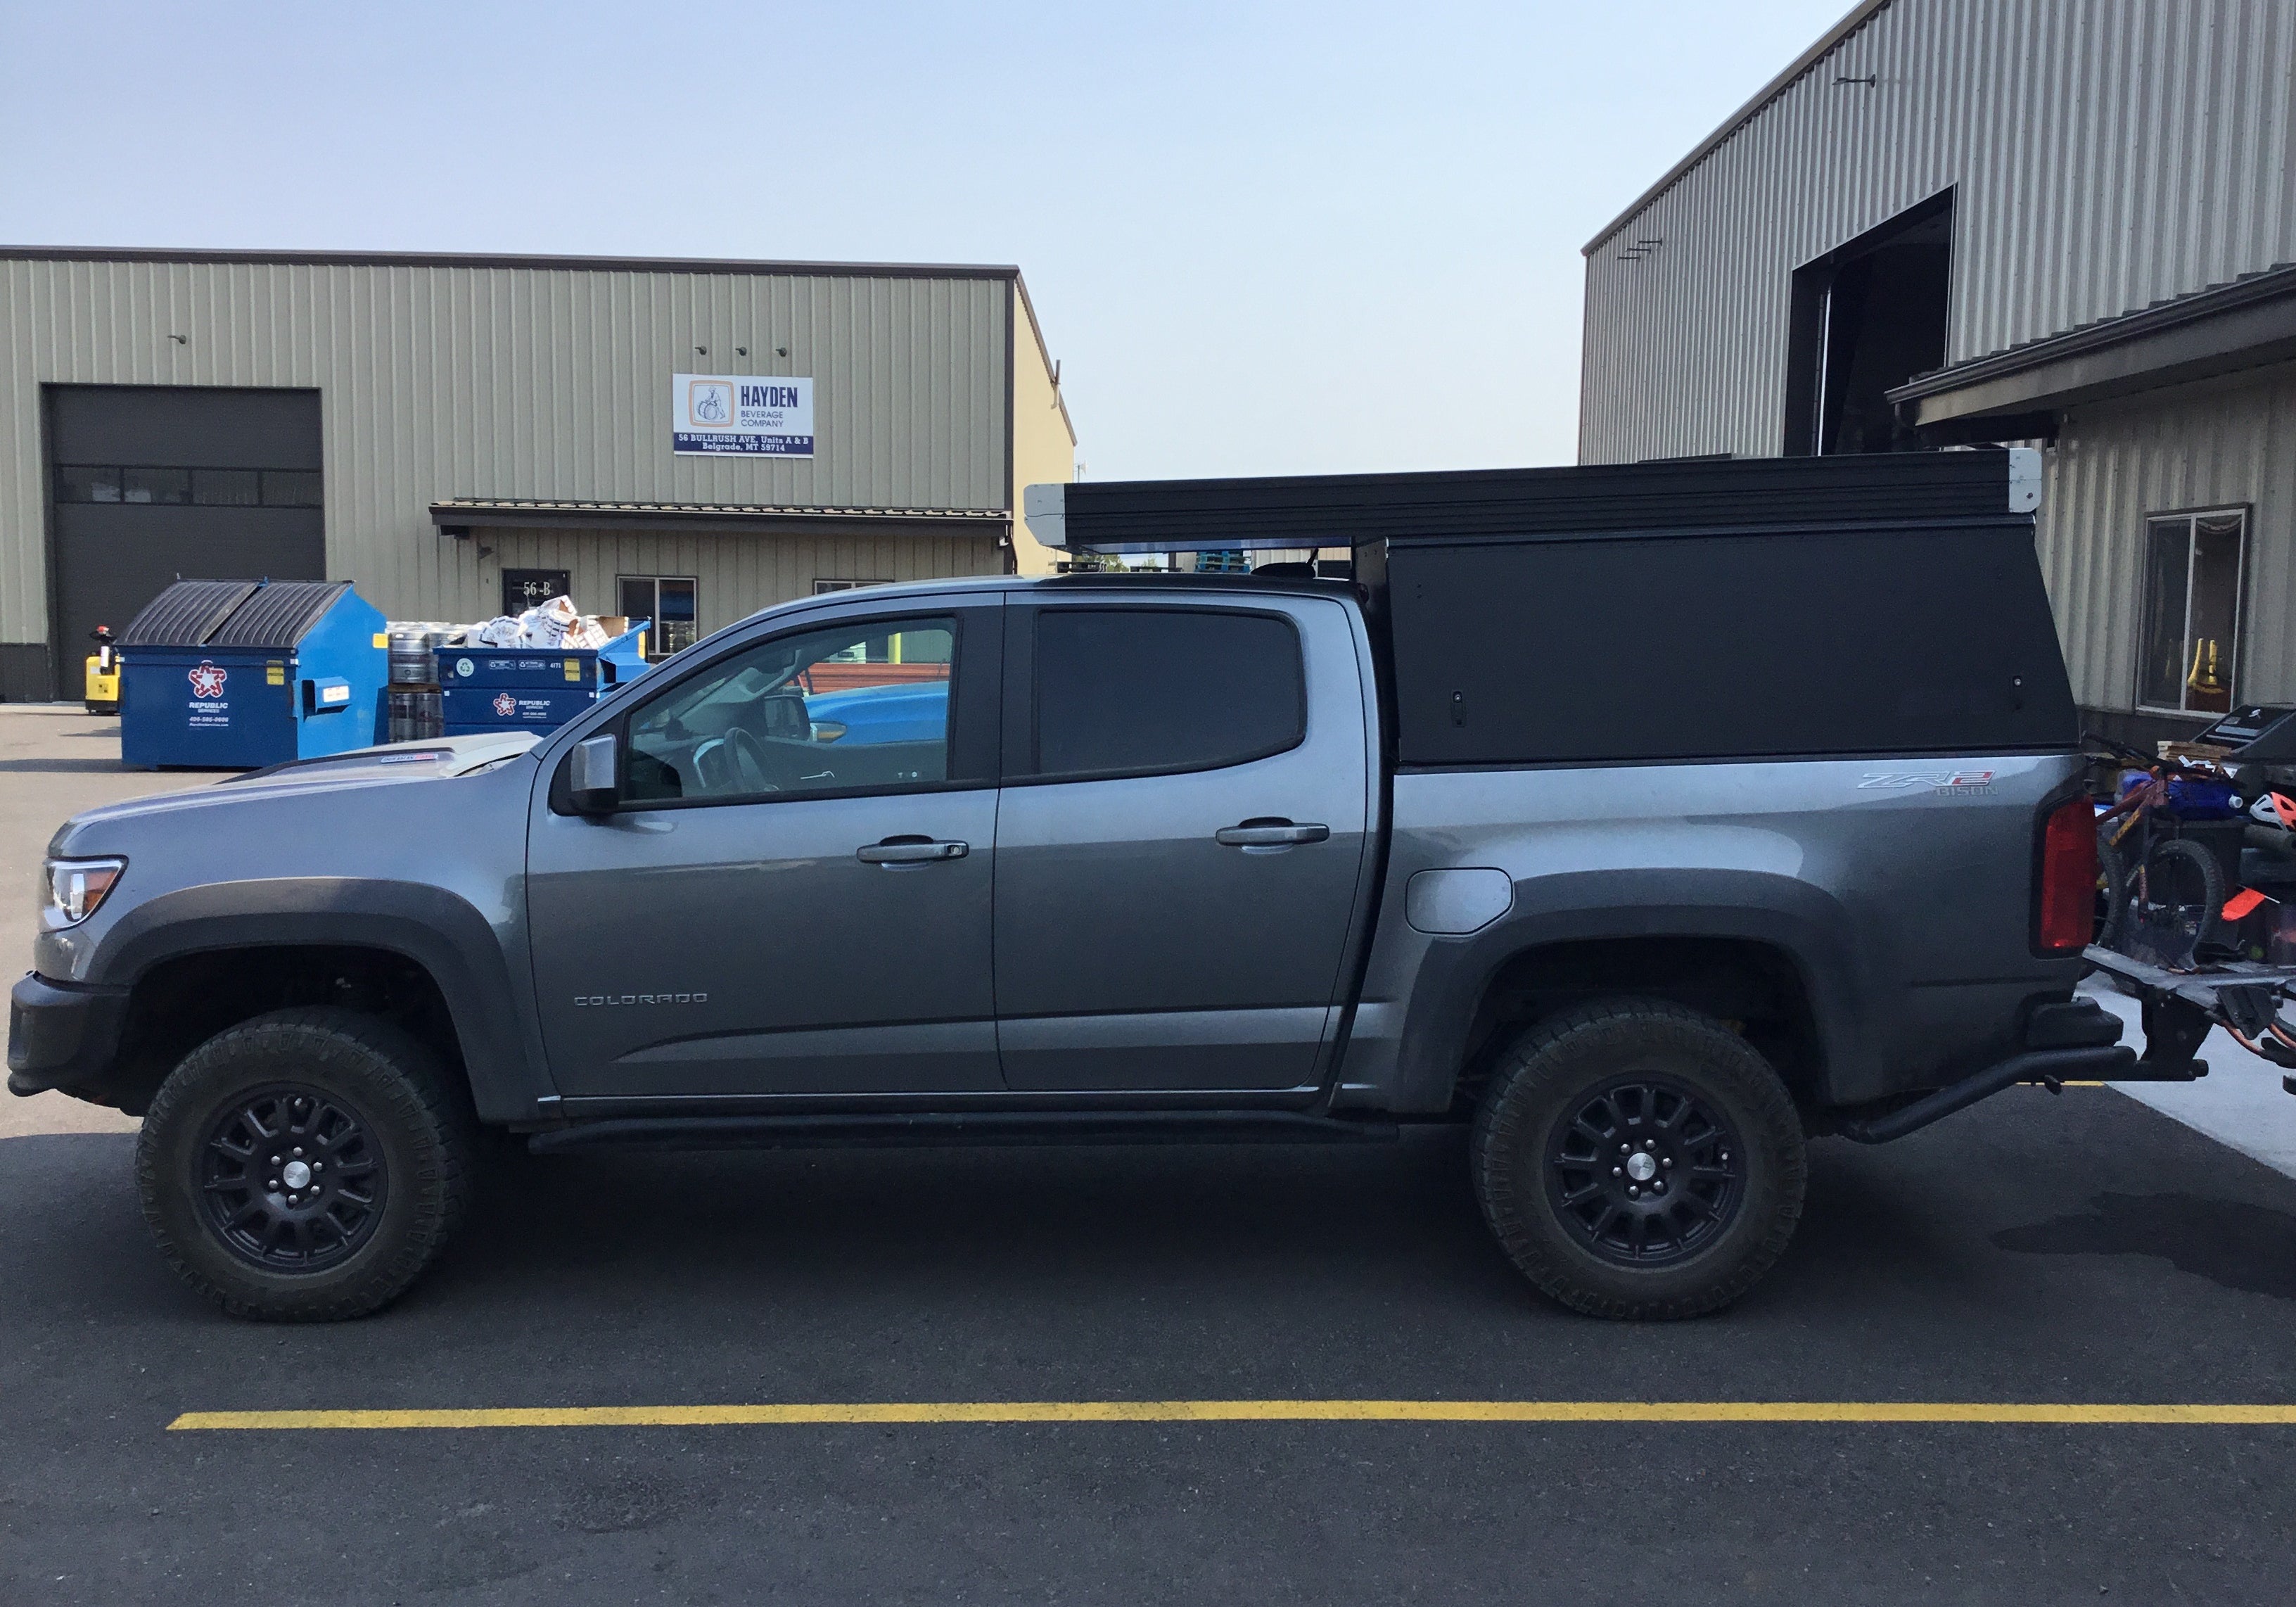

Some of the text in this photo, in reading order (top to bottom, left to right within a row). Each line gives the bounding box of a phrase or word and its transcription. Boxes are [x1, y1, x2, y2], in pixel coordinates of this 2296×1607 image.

[741, 386, 798, 407] HAYDEN
[741, 410, 784, 419] BEVERAGE
[741, 419, 784, 427] COMPANY
[678, 433, 689, 442] 56
[690, 433, 736, 443] BULLRUSH
[702, 442, 743, 452] Belgrade,
[760, 443, 786, 452] 59714
[1857, 770, 1996, 789] ZR2
[1937, 785, 1998, 796] BISON
[574, 993, 708, 1006] COLORADO
